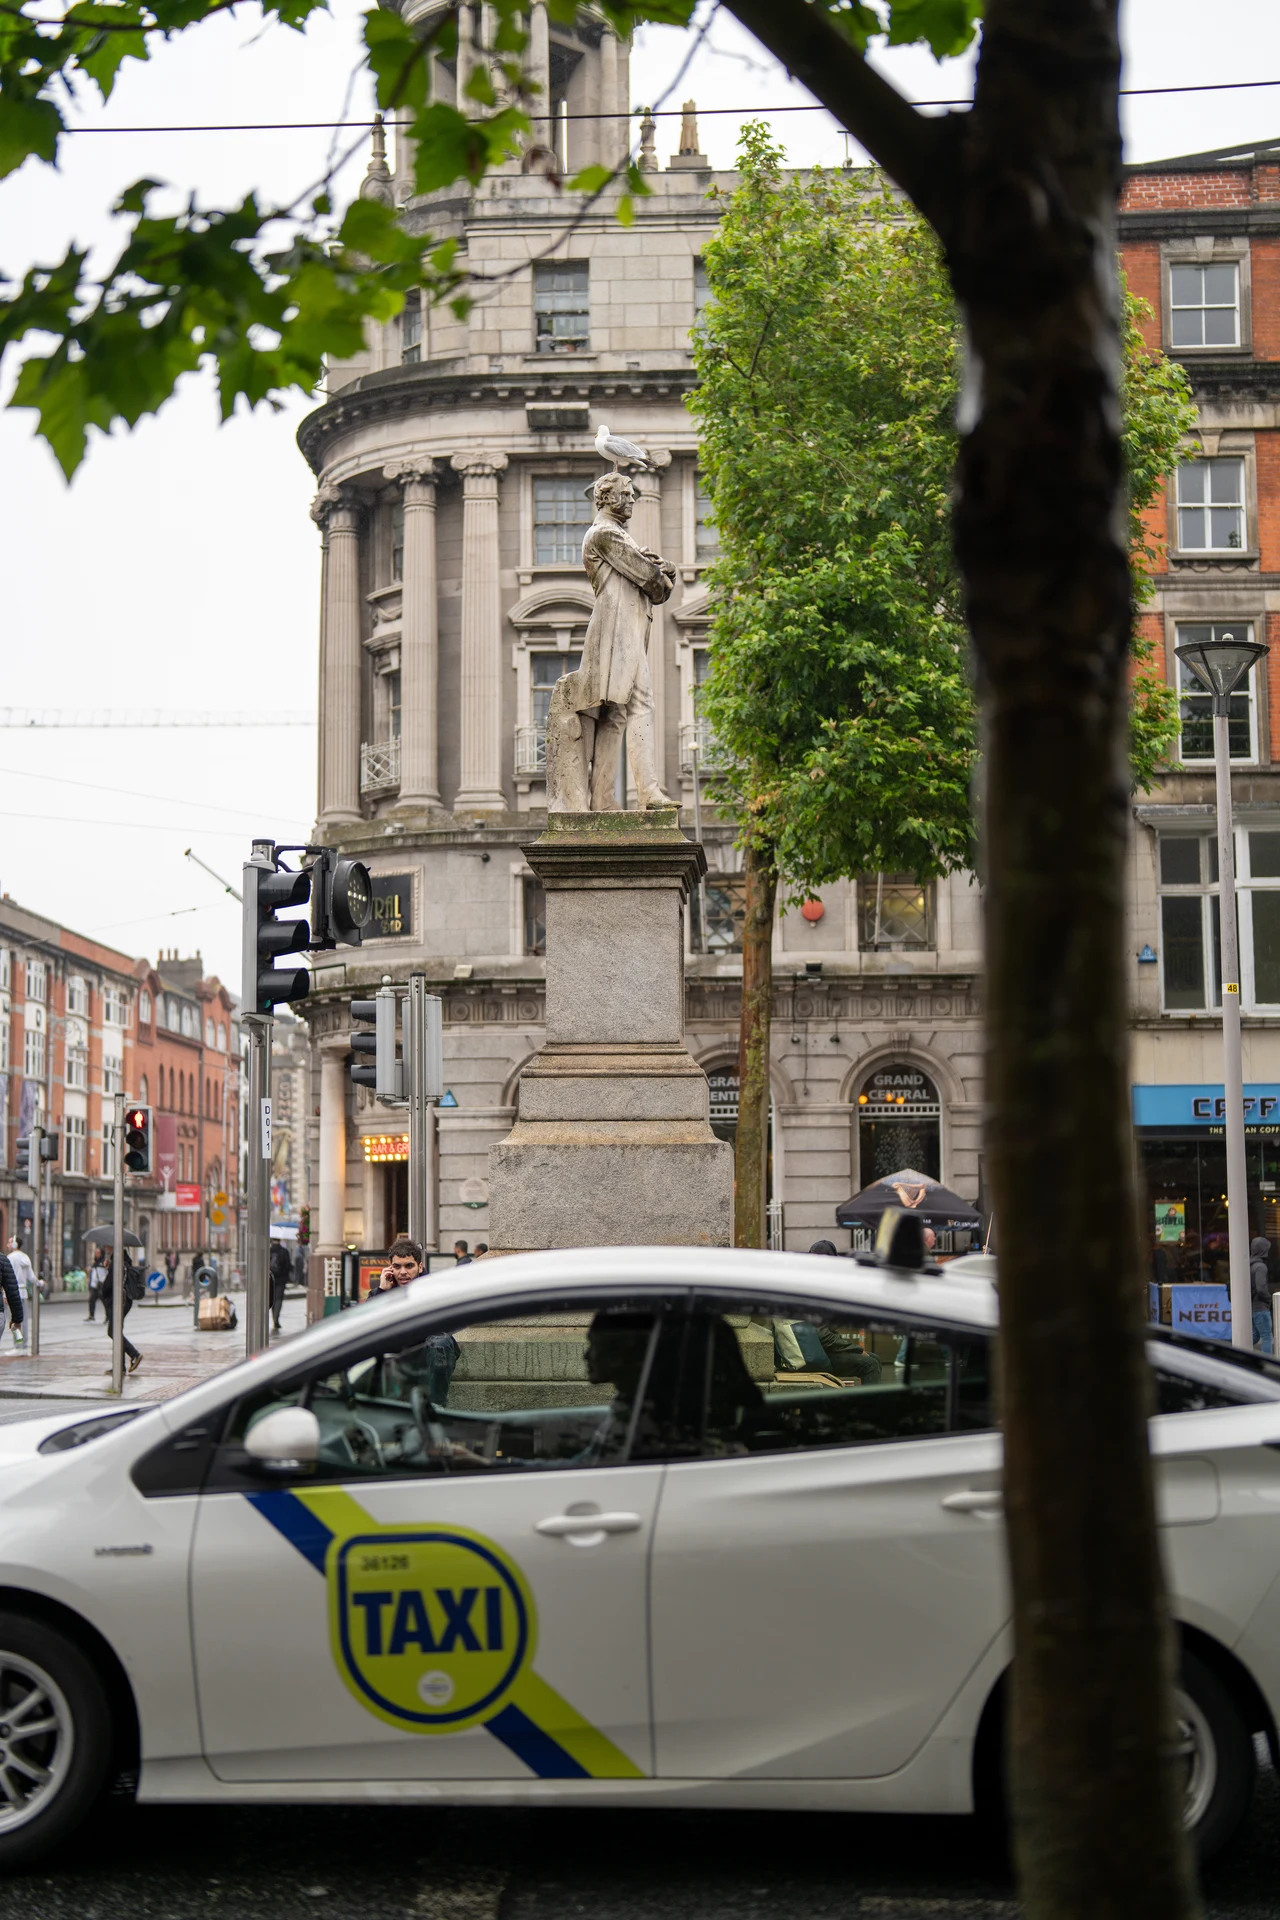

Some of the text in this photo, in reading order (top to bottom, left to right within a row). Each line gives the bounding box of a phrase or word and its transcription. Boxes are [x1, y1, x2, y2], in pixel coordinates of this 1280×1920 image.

[1227, 984, 1238, 993] 48
[708, 1077, 740, 1088] GRA
[873, 1074, 924, 1086] GRAND
[710, 1091, 739, 1102] ENT
[1192, 1096, 1280, 1118] CAFF
[1209, 1126, 1224, 1134] THE
[1259, 1126, 1280, 1134] COFF
[371, 1143, 388, 1154] BAR
[396, 1142, 410, 1153] GR
[352, 1587, 504, 1657] TAXI
